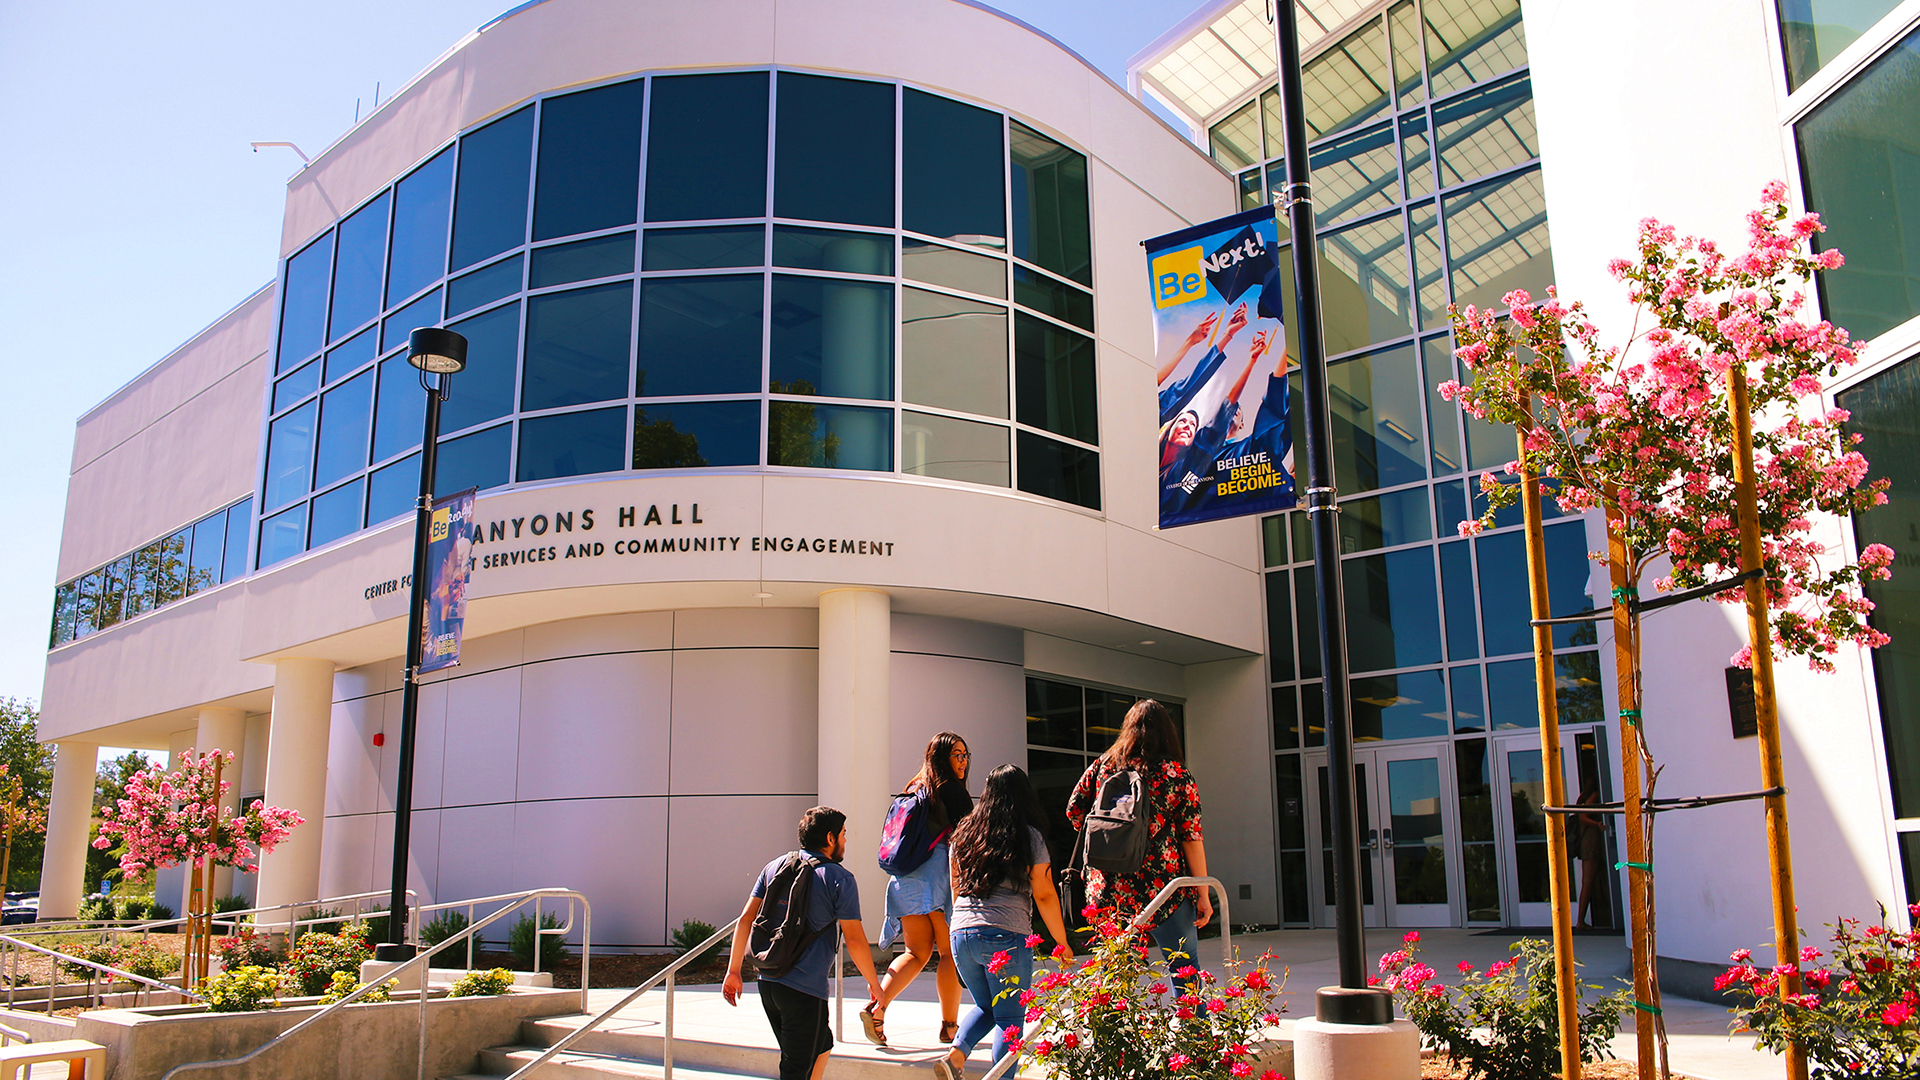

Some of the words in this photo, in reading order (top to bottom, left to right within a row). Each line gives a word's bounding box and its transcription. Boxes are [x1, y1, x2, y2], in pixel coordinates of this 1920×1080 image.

[1158, 271, 1201, 301] Be
[1198, 231, 1266, 278] Next!
[1216, 451, 1271, 472] BELIEVE.
[1230, 462, 1276, 481] BEGIN.
[1217, 472, 1287, 497] BECOME.
[432, 520, 447, 538] Be
[447, 500, 473, 525] Ready!
[471, 508, 594, 546] ANYONS
[618, 503, 703, 528] HALL
[364, 579, 398, 600] CENTER
[401, 574, 413, 589] FO
[483, 546, 556, 570] SERVICES
[565, 542, 605, 559] AND
[614, 537, 741, 555] COMMUNITY
[751, 537, 895, 557] ENGAGEMENT
